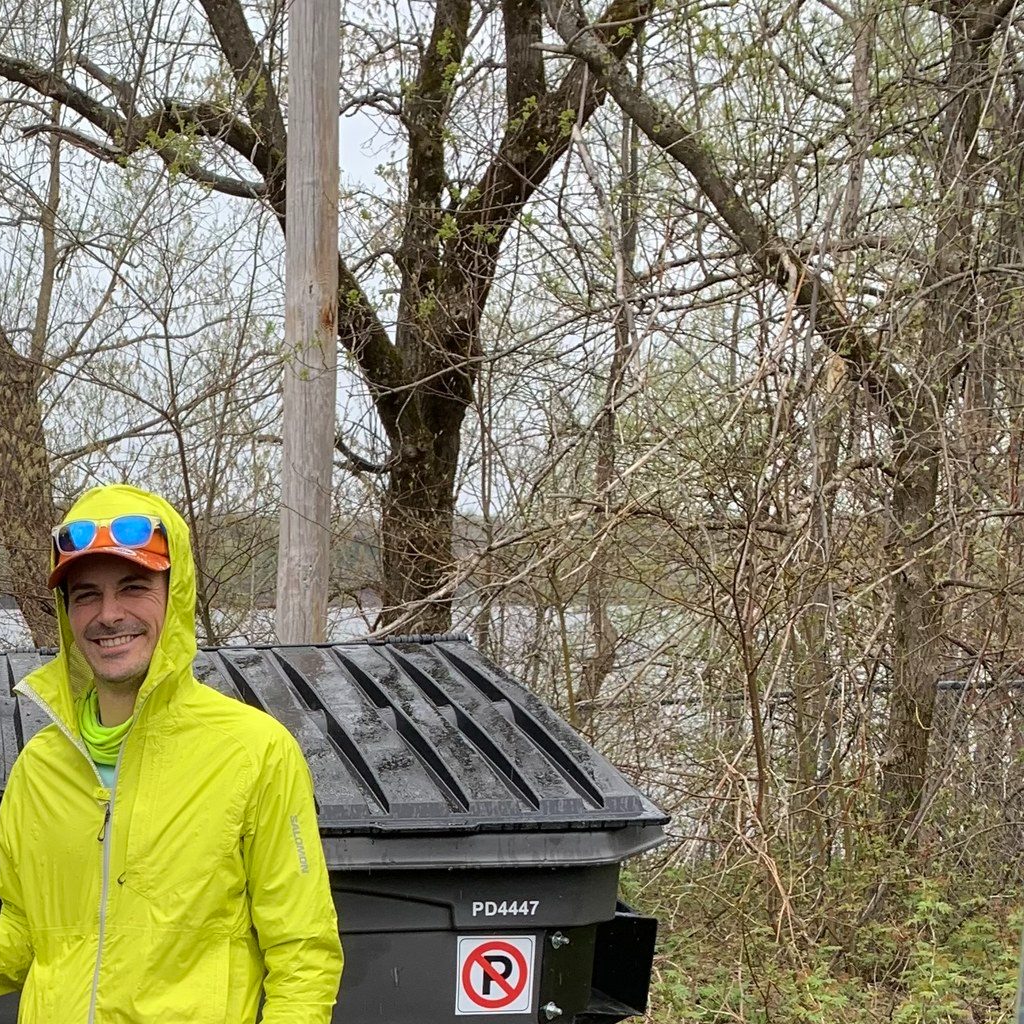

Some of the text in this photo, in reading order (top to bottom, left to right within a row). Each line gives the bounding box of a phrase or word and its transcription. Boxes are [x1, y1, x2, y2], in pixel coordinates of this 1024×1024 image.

[289, 814, 309, 874] SALOMON
[472, 900, 540, 917] PD4447
[482, 955, 513, 996] P
